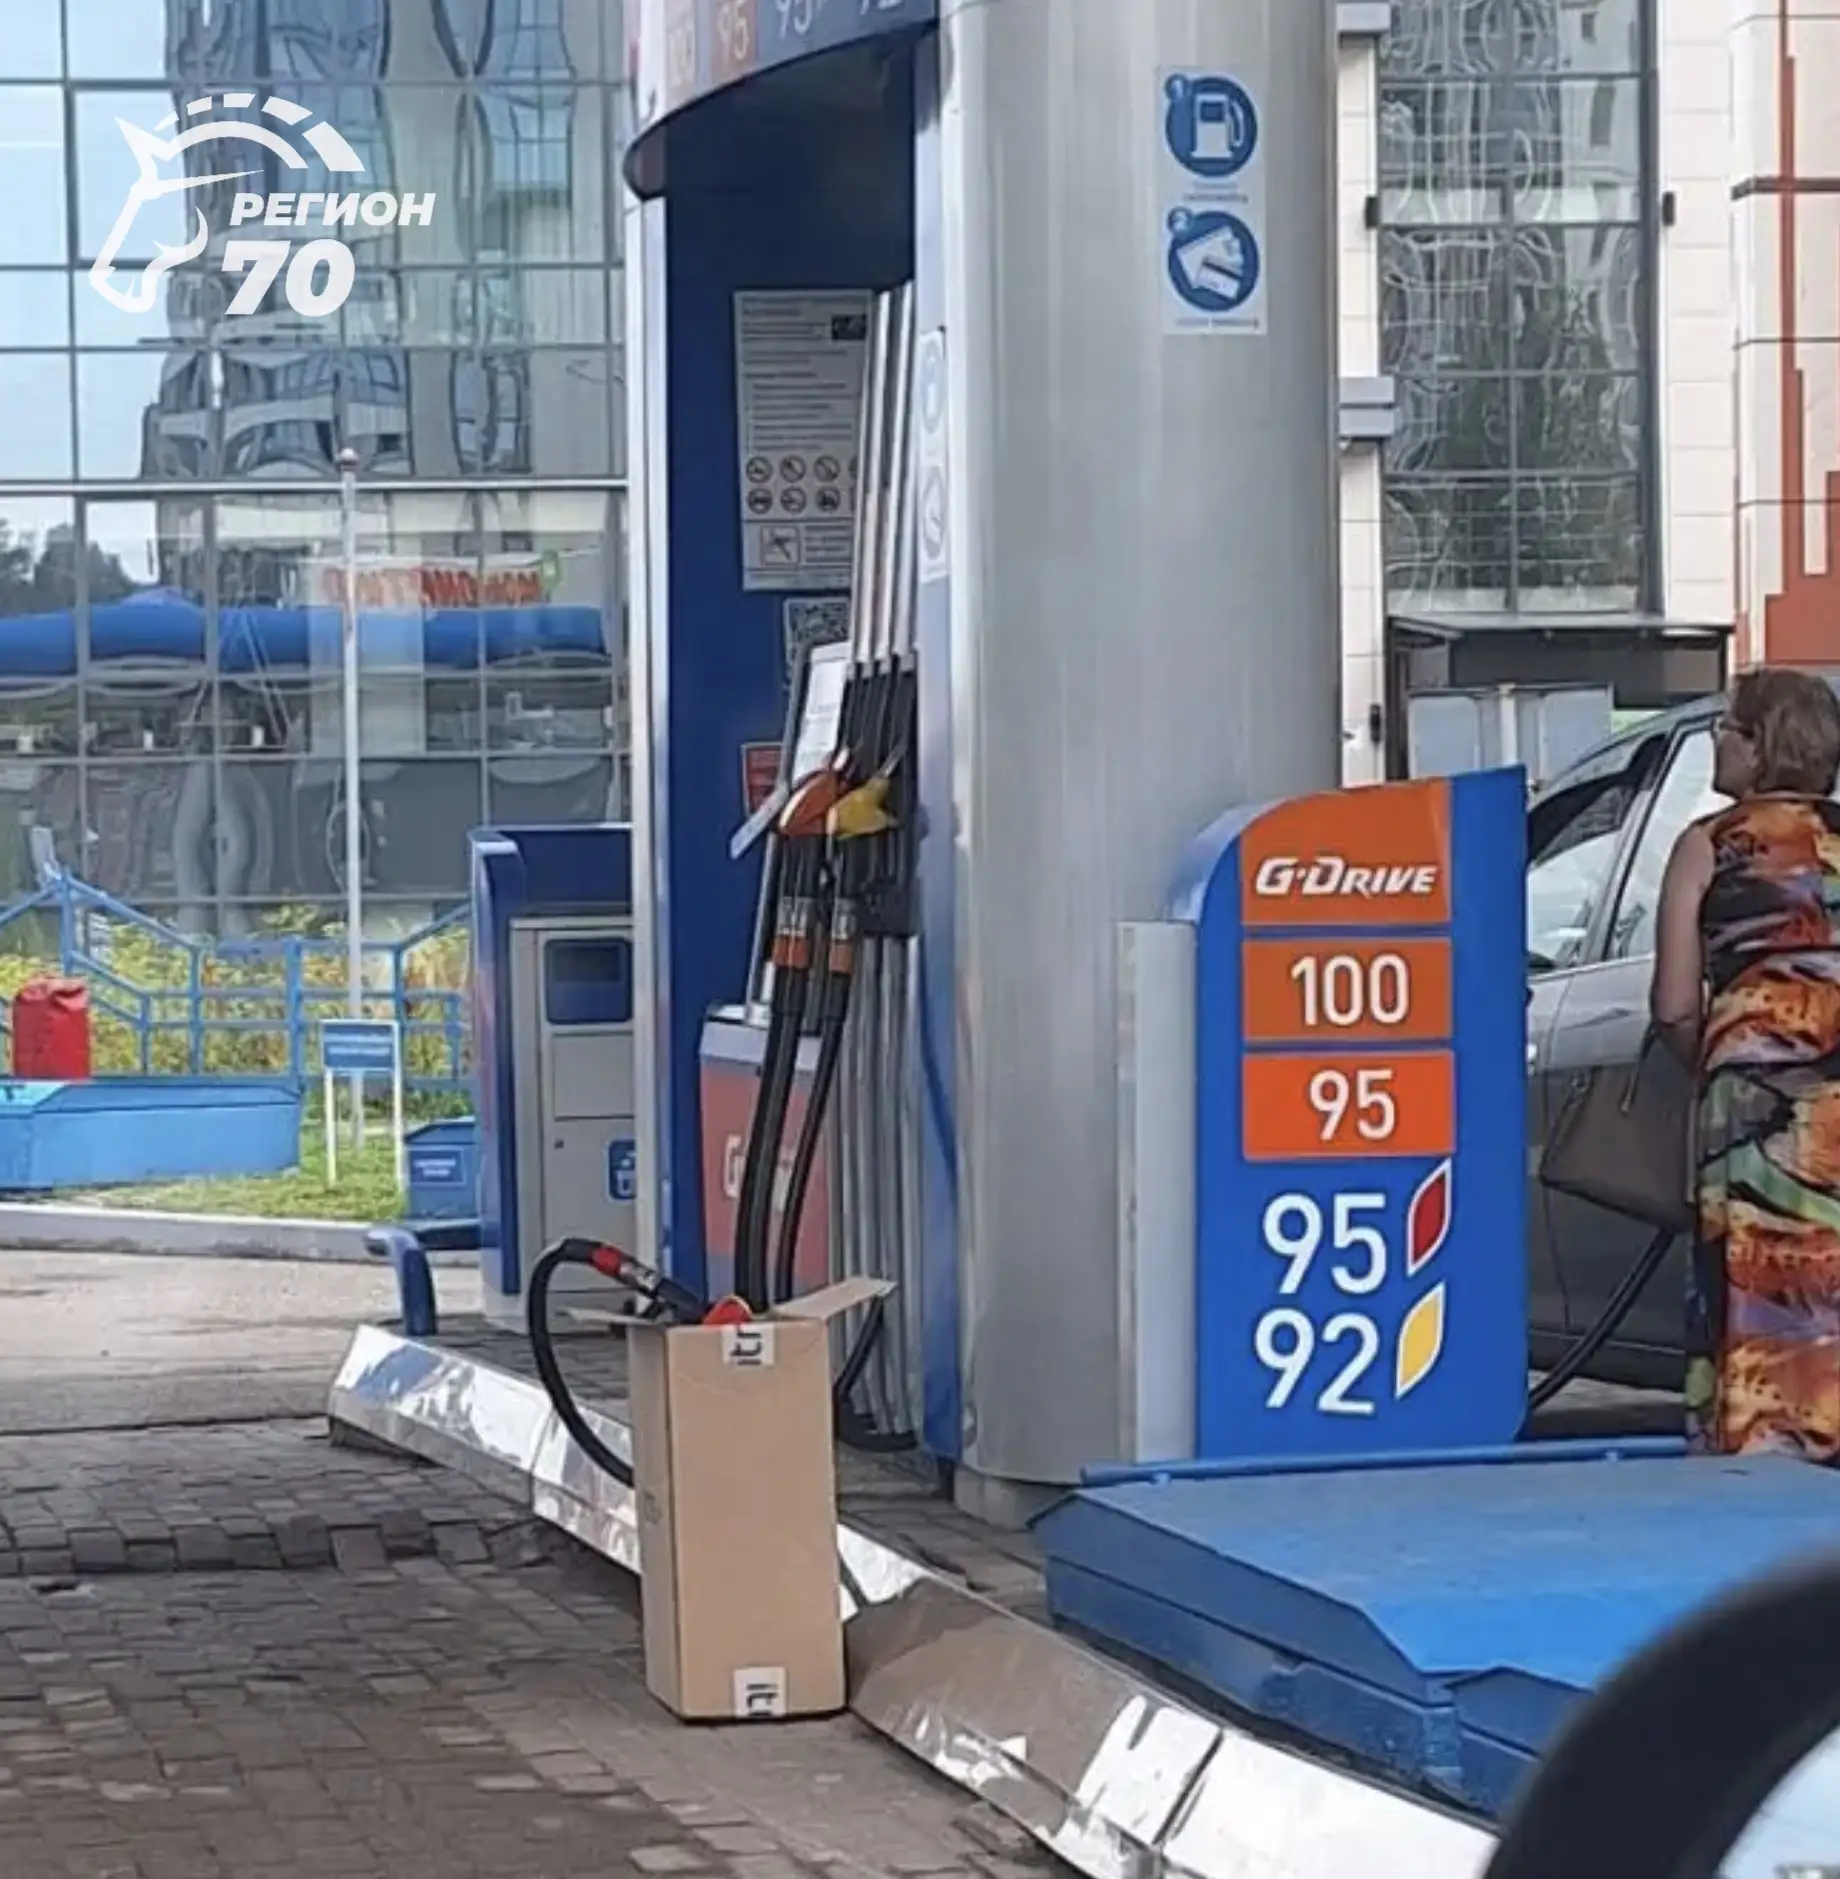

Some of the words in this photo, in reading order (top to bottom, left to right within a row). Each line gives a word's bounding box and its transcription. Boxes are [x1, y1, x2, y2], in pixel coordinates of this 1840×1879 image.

[716, 0, 751, 61] 95
[1290, 955, 1410, 1026] 100
[1309, 1069, 1396, 1140] 95
[1263, 1193, 1387, 1295] 95
[1255, 1308, 1380, 1415] 92
